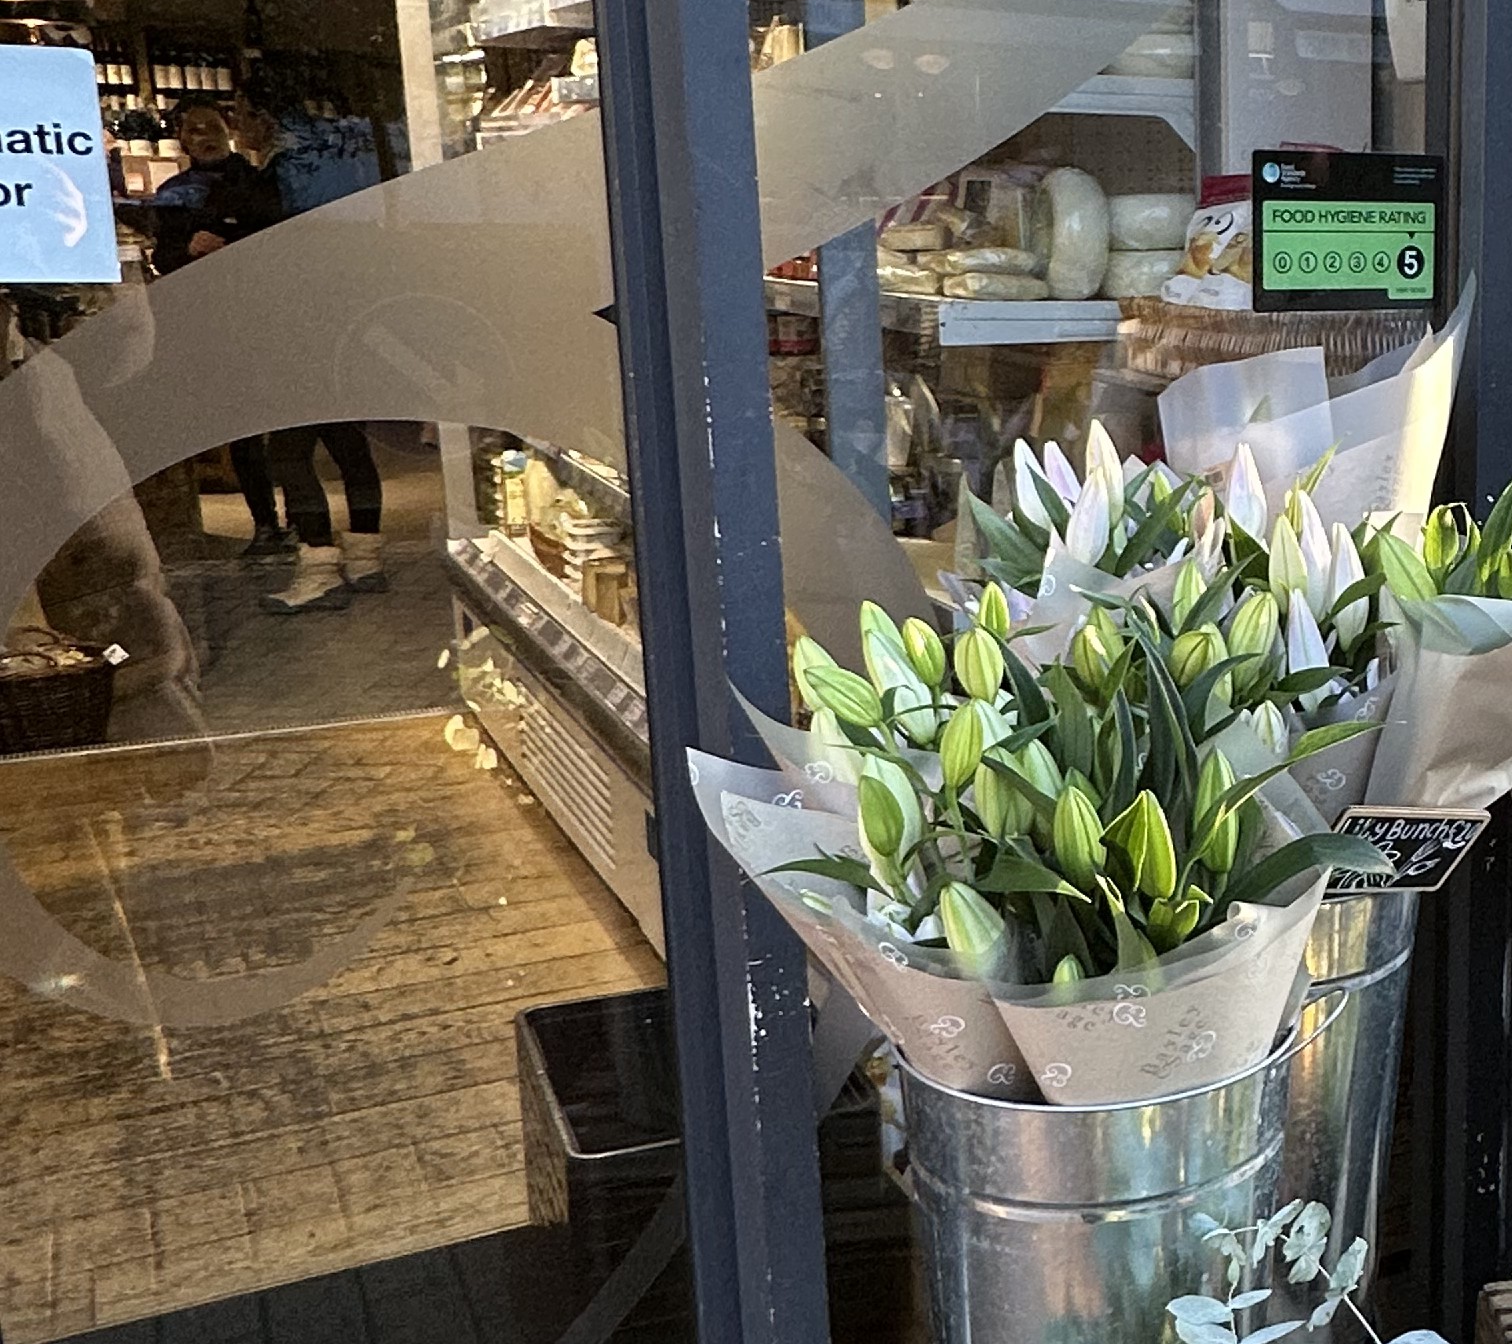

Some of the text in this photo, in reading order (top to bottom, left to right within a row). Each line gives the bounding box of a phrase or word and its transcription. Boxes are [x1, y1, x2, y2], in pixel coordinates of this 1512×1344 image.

[0, 122, 94, 156] atic
[1271, 208, 1427, 225] FOOD HYGIENE RATING
[1403, 250, 1419, 275] 5
[1385, 818, 1450, 840] Bunch
